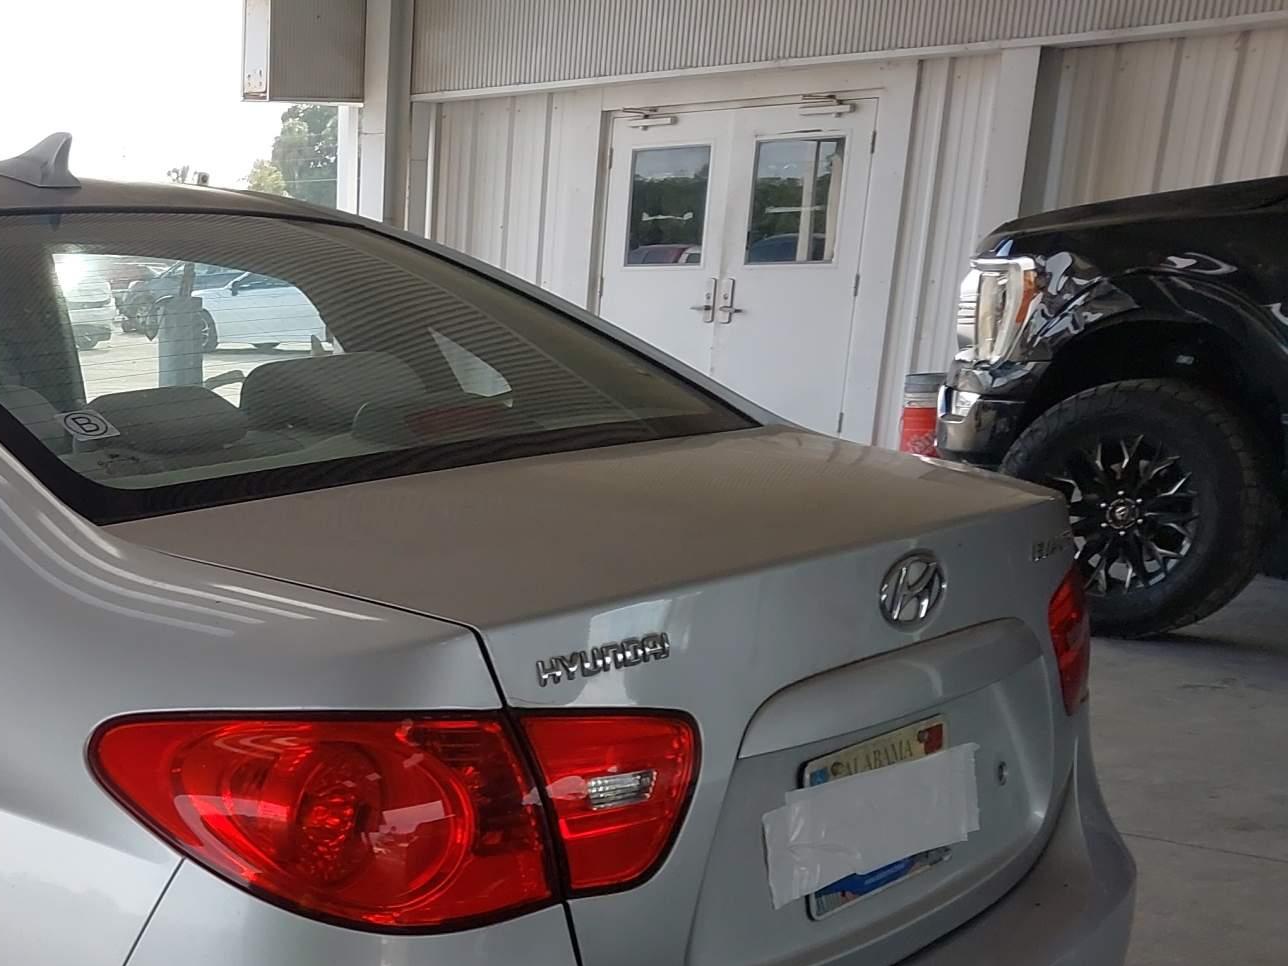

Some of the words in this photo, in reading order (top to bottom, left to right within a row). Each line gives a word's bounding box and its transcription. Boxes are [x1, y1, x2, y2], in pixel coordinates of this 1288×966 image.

[72, 416, 99, 433] B
[536, 632, 669, 687] HYUNDAI
[845, 738, 914, 776] ALABAMA
